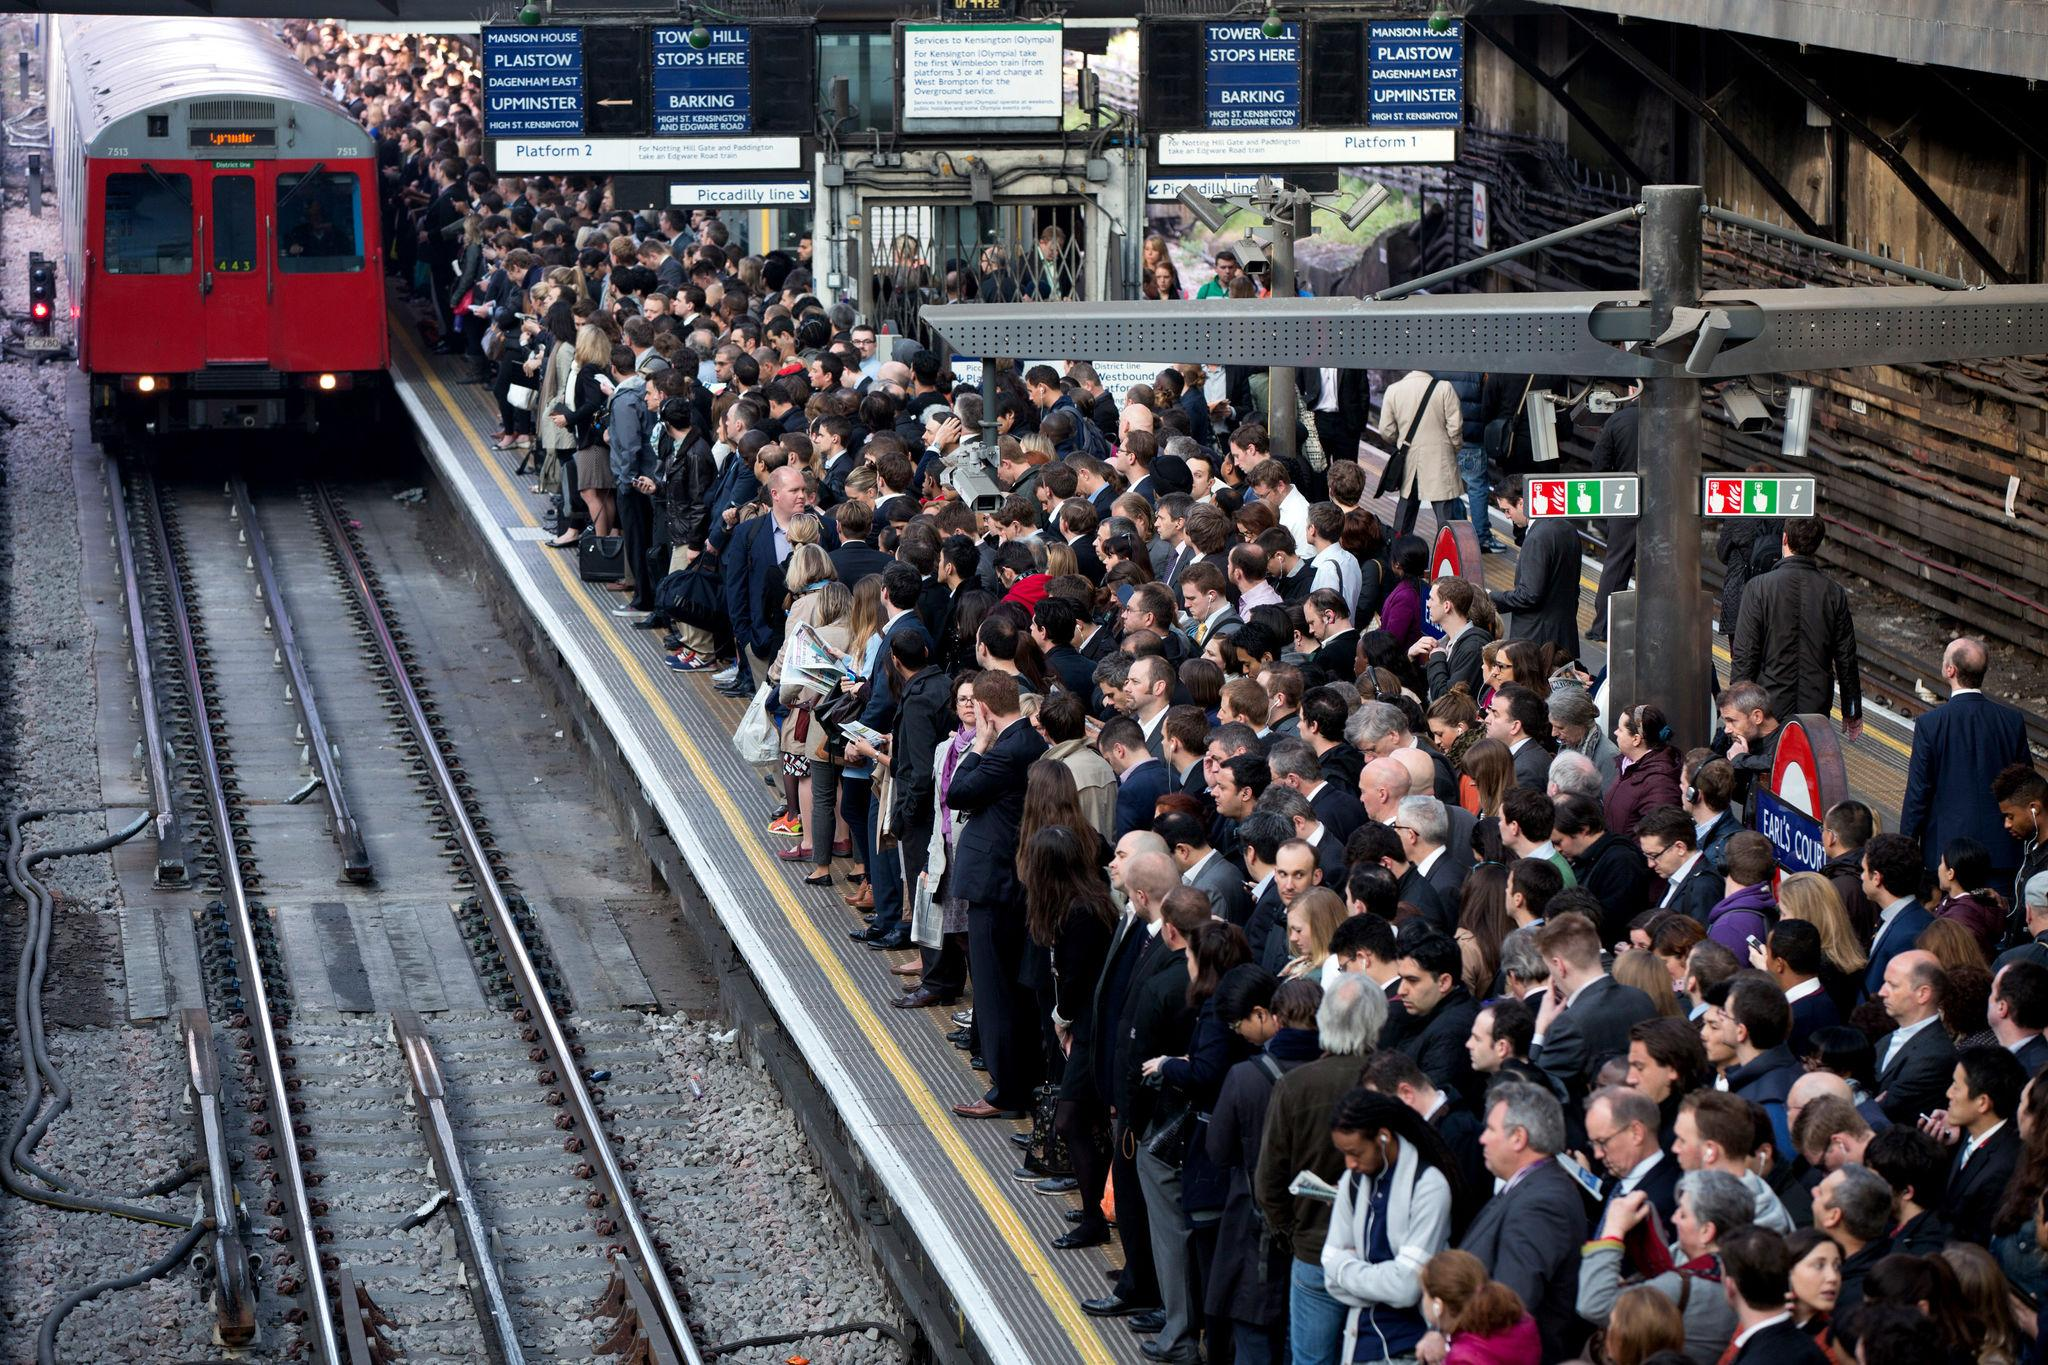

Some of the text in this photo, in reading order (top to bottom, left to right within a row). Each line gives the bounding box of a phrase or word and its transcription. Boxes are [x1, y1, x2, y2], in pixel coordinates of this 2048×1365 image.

[656, 30, 744, 43] TOW HILL
[1209, 28, 1261, 40] TOWER
[1372, 27, 1458, 37] MANSION HOUSE
[488, 33, 577, 43] MANSION HOUSE
[914, 37, 949, 45] Services
[965, 36, 1012, 45] Kensington
[1014, 35, 1055, 46] (Olympia)
[657, 52, 745, 65] STOPS HERE
[930, 50, 976, 59] Kensington
[1209, 49, 1296, 62] STOPS HERE
[1378, 47, 1453, 60] PLAISTOW
[494, 53, 572, 67] PLAISTOW
[914, 69, 954, 78] platforms
[956, 68, 962, 76] 3
[1003, 69, 1033, 77] change
[1372, 69, 1458, 79] DAGENHAM EAST
[489, 77, 577, 87] DAGENHAM EAST
[938, 78, 979, 87] Brompton
[914, 87, 962, 97] Overground
[1221, 90, 1285, 103] BARKING
[1374, 89, 1456, 102] UPMINSTER
[491, 97, 577, 110] UPMINSTER
[669, 95, 735, 108] BARKING
[657, 114, 746, 123] HIGH ST. KENSINGTON
[1209, 110, 1230, 118] HIGH
[1231, 110, 1242, 118] ST.
[1372, 113, 1392, 121] HIGH
[1405, 112, 1458, 120] KENSINGTON
[489, 121, 579, 129] HIGH ST. KENSINGTON
[680, 123, 719, 131] EDGWARE
[720, 122, 744, 130] ROAD
[1231, 118, 1270, 126] EDGWARE
[1345, 136, 1417, 149] Platform 1
[107, 148, 129, 157] 7513
[336, 147, 358, 156] 7513
[516, 144, 593, 158] Platform 2
[215, 161, 239, 169] District
[1233, 182, 1257, 195] line
[697, 189, 795, 204] Piccadilly line
[1094, 362, 1141, 370] District line
[1763, 809, 1791, 853] EARL'S
